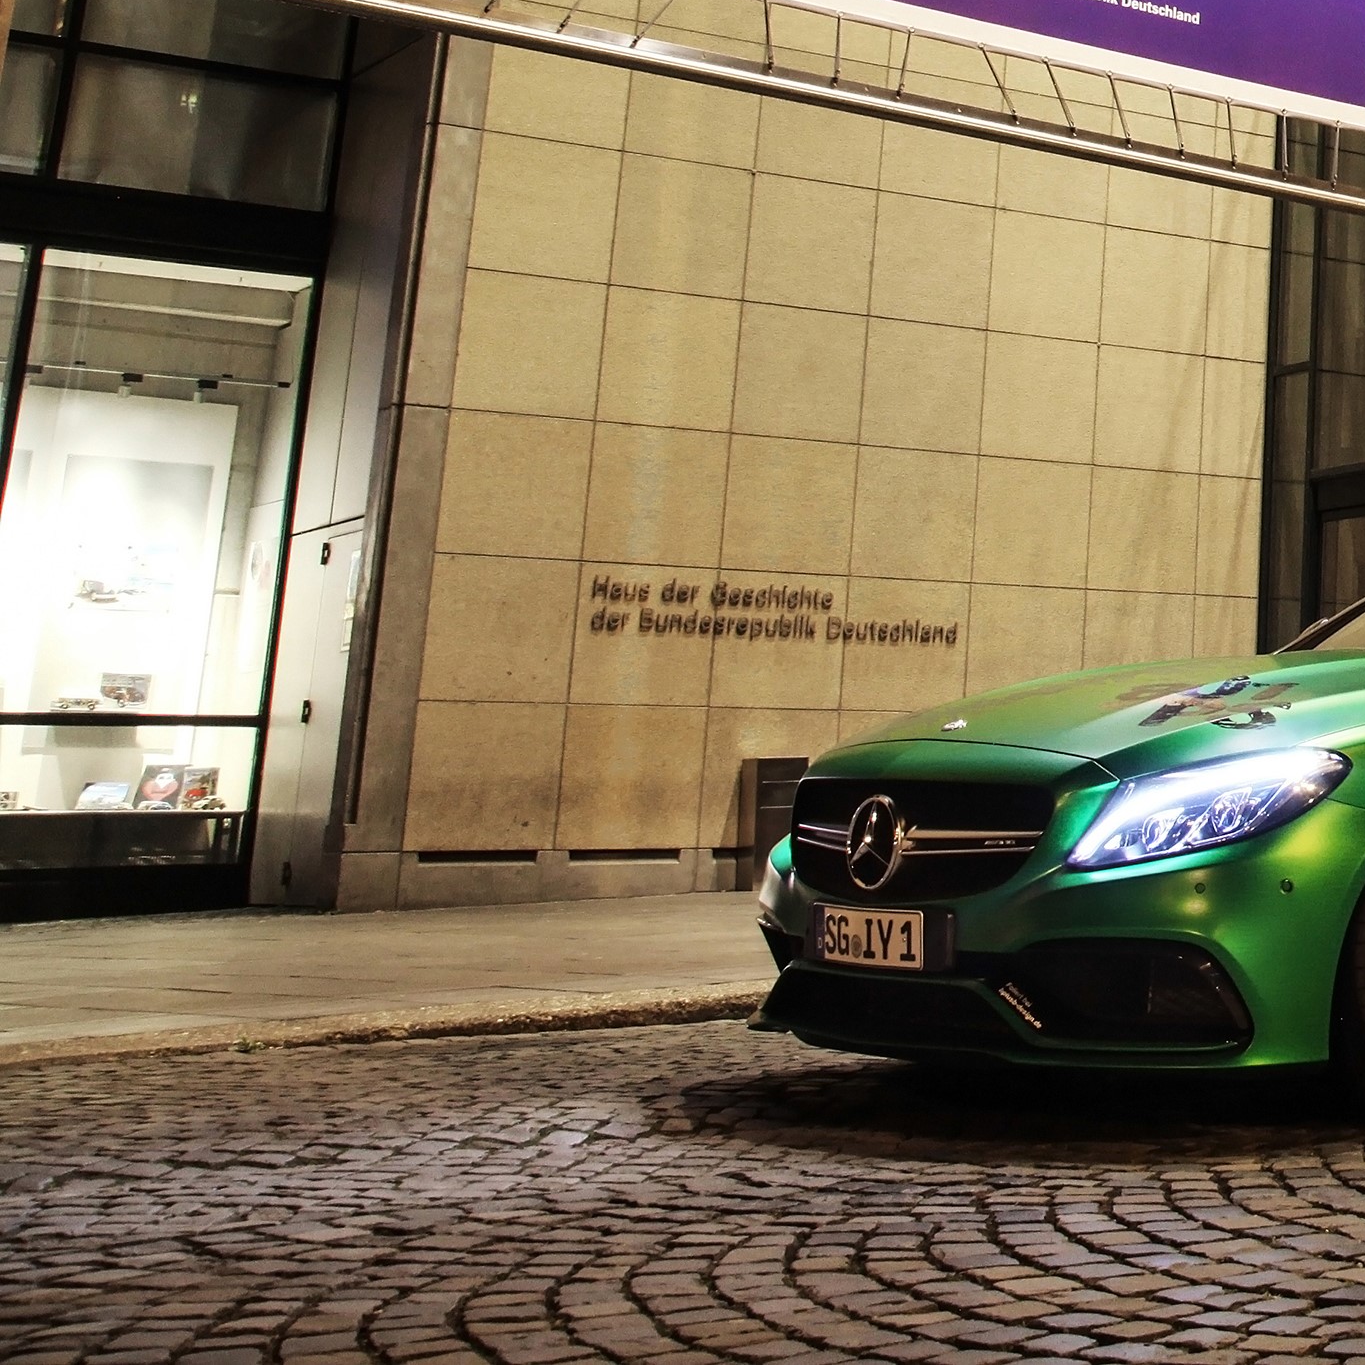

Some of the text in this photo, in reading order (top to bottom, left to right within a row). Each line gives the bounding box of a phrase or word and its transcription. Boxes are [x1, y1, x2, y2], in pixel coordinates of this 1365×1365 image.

[591, 574, 834, 611] Haus der Geschichte
[591, 606, 958, 644] der Bundesrepublik Deutschland
[825, 914, 916, 962] SG IY 1
